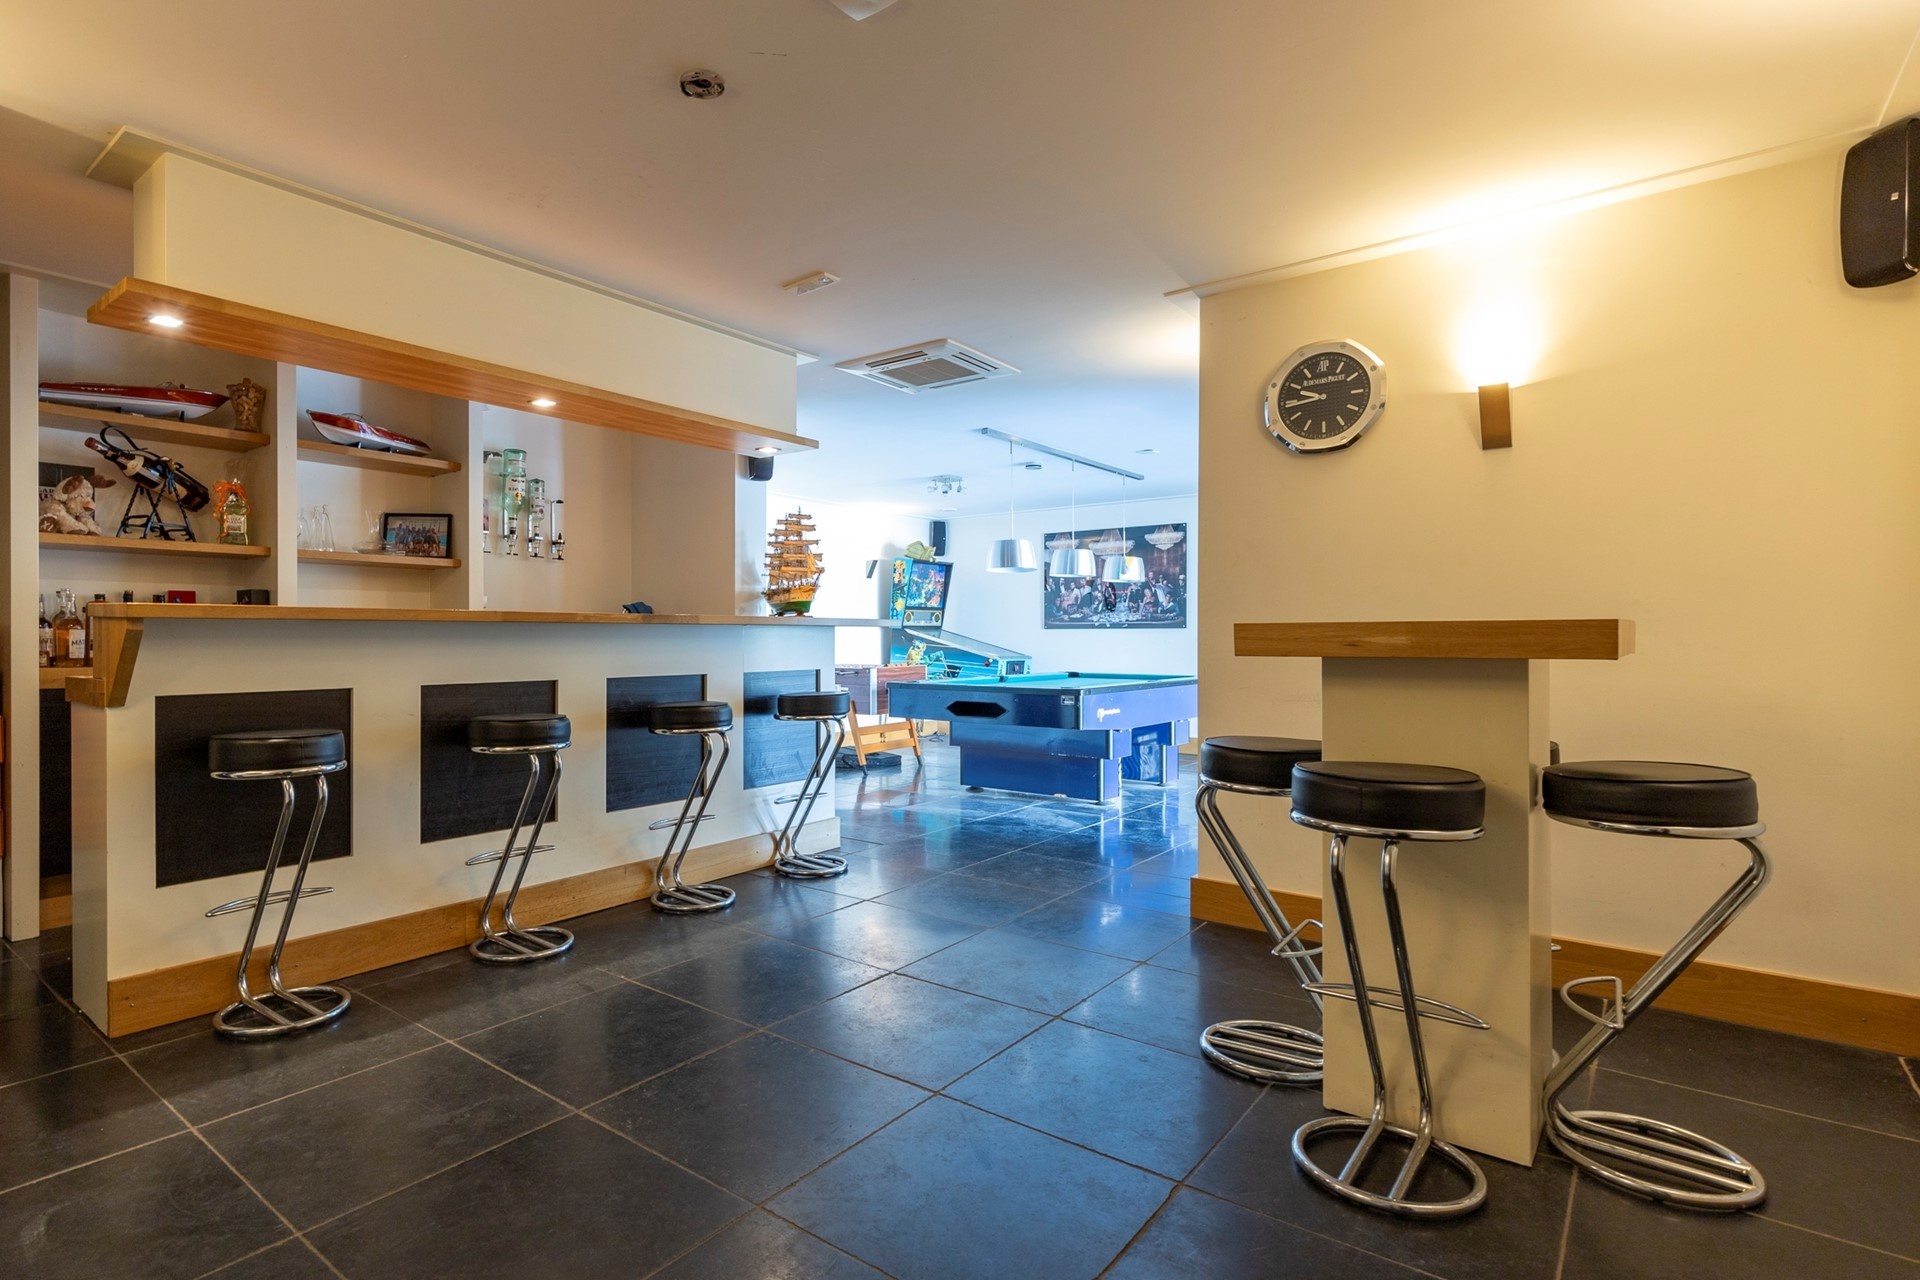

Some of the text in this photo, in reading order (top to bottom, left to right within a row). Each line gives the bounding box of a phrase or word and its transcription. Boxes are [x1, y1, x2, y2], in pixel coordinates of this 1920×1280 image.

[1317, 360, 1329, 372] AP
[1302, 374, 1345, 387] AUDEMARS PIGUET
